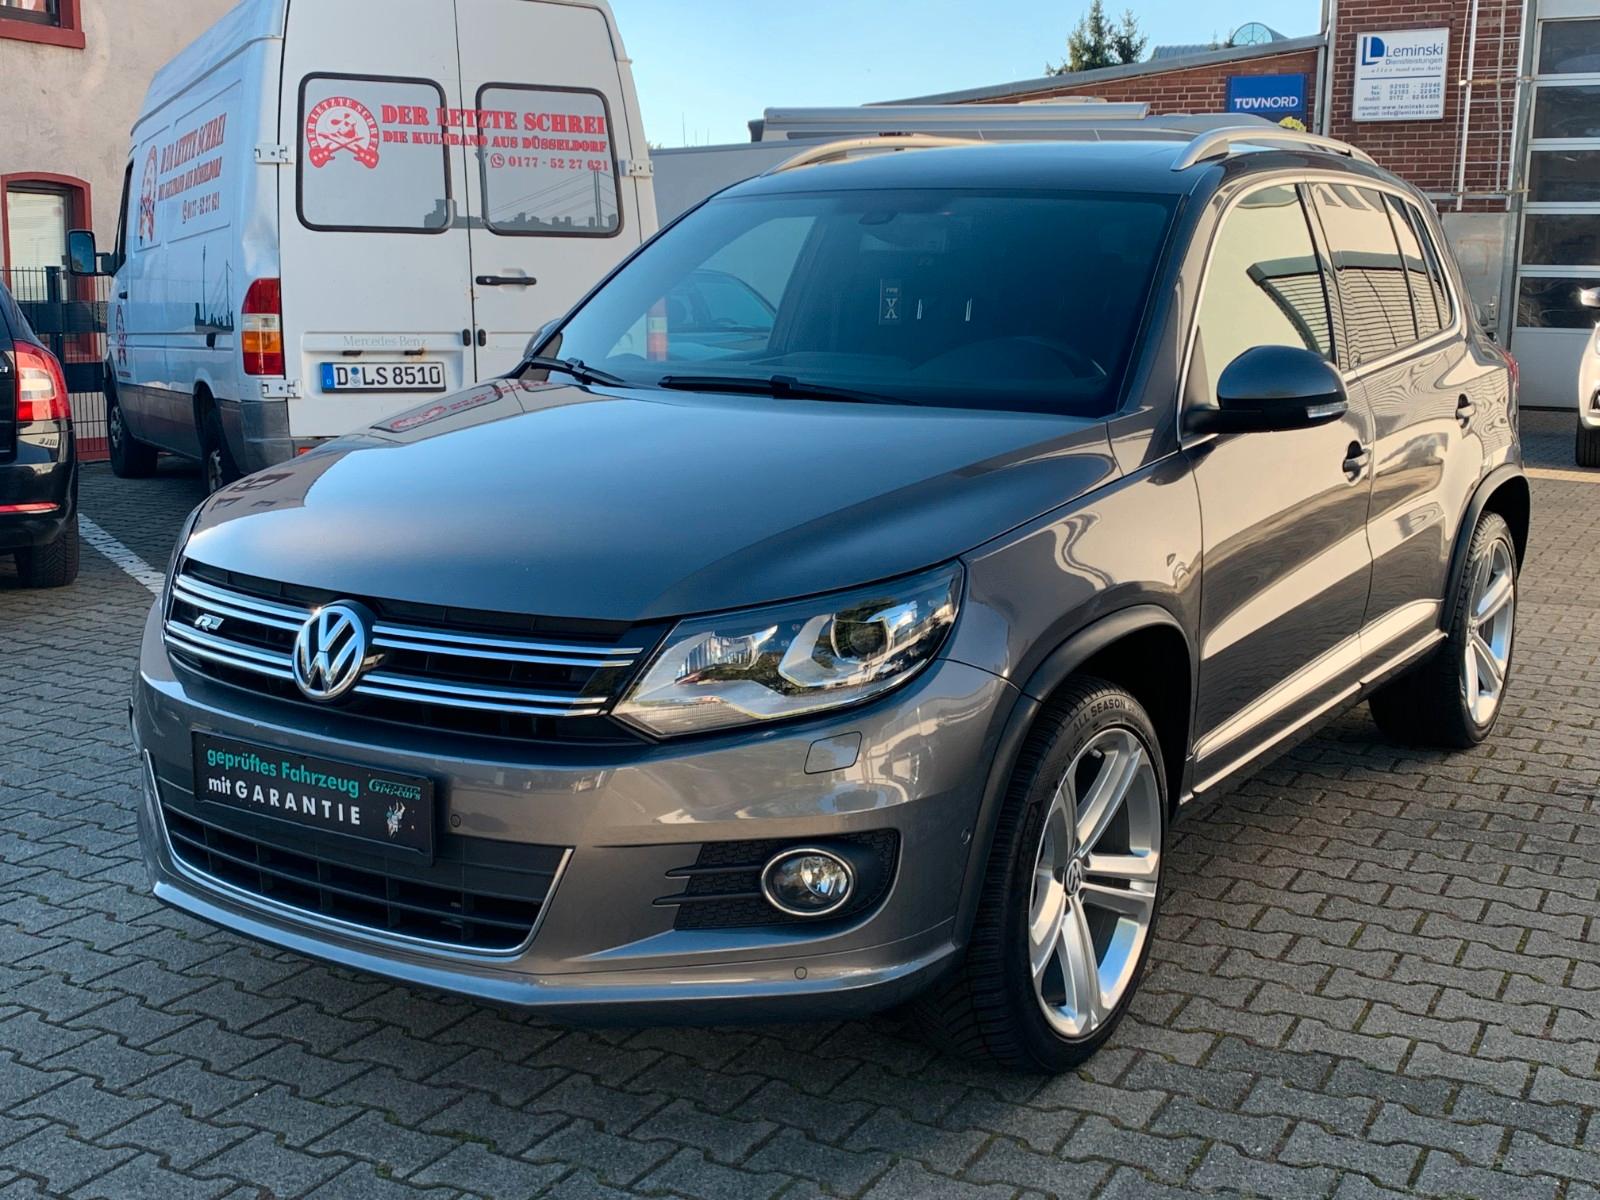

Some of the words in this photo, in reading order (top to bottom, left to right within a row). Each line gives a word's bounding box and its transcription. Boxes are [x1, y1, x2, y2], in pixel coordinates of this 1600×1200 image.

[1386, 43, 1444, 57] Leminski
[381, 104, 430, 126] DER
[436, 107, 518, 130] LETZTE
[523, 112, 606, 134] SCHREI
[382, 130, 408, 144] DIE
[491, 135, 518, 148] AUS
[522, 136, 607, 152] DÜSSELDORF
[508, 156, 539, 168] 0177
[550, 158, 565, 168] 52
[569, 158, 582, 170] 27
[336, 367, 348, 386] D
[362, 366, 388, 386] LS
[393, 366, 441, 385] 8510
[1090, 698, 1126, 718] SEASON
[207, 749, 276, 777] geprüftes
[281, 762, 359, 798] Fahrzeug
[208, 776, 231, 795] mit
